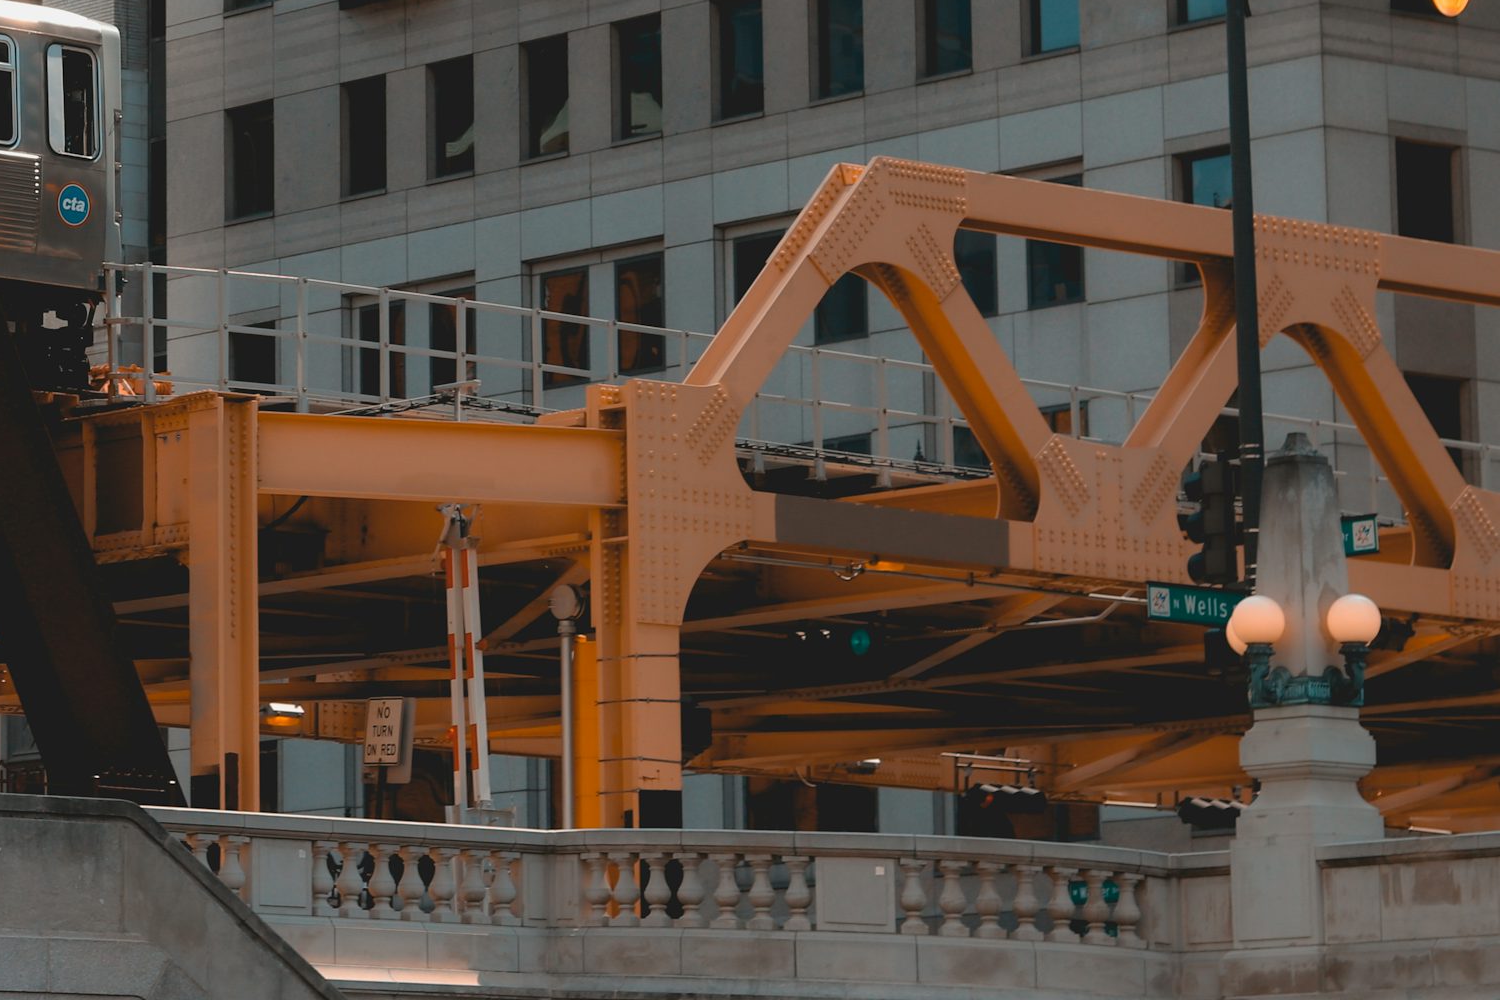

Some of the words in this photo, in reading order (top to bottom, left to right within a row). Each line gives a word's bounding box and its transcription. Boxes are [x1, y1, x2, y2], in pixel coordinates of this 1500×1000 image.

[63, 197, 86, 212] cta
[1173, 599, 1180, 609] N
[1184, 594, 1229, 618] Wells
[377, 707, 391, 718] NO
[372, 725, 393, 737] TURN
[367, 744, 377, 755] ON
[381, 744, 396, 755] RED
